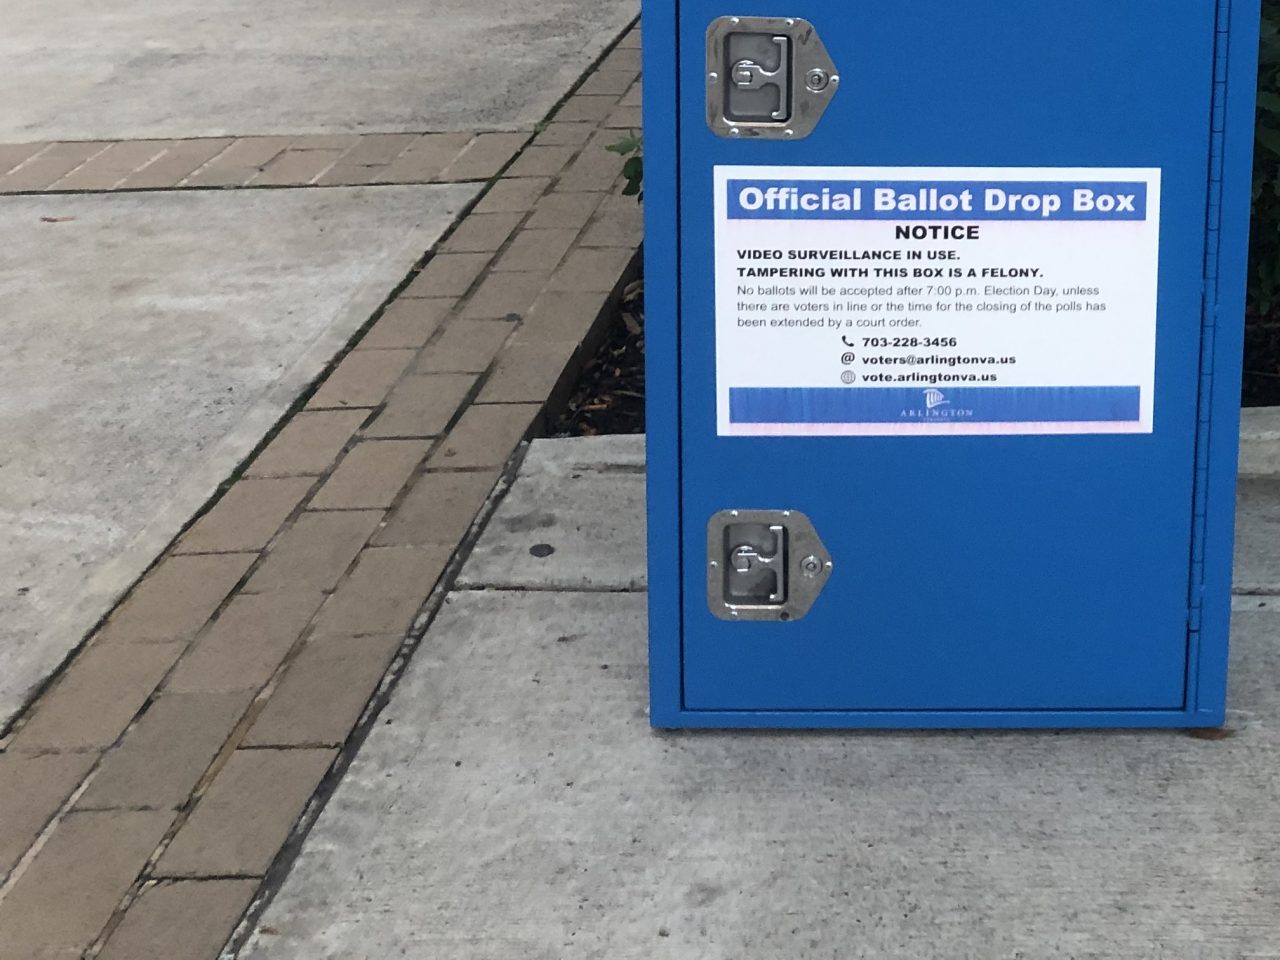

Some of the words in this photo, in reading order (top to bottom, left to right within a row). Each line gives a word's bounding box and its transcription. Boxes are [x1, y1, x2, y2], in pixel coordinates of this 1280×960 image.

[739, 187, 862, 210] Official
[874, 188, 973, 211] Ballot
[984, 189, 1061, 217] Drop
[1073, 189, 1136, 211] Box
[895, 226, 980, 240] NOTICE
[737, 250, 783, 260] VIDEO
[788, 250, 902, 260] SURVEILLANCE
[907, 250, 922, 260] IN
[927, 250, 961, 260] USE.
[737, 268, 825, 278] TAMPERING
[830, 268, 869, 278] WITH
[874, 268, 908, 278] THIS
[913, 268, 943, 278] BOX
[949, 268, 962, 278] IS
[967, 268, 977, 278] A
[982, 268, 1044, 278] FELONY.
[737, 285, 754, 296] No
[757, 285, 796, 296] ballots
[799, 285, 818, 296] will
[821, 285, 836, 296] be
[840, 285, 893, 298] accepted
[896, 285, 922, 296] after
[926, 285, 951, 296] 7:00
[955, 288, 980, 298] p.m.
[984, 285, 1029, 296] Election
[1034, 285, 1058, 298] Day,
[1062, 285, 1100, 296] unless
[737, 301, 767, 312] there
[771, 304, 790, 312] are
[793, 302, 830, 312] voters
[832, 301, 843, 312] in
[847, 301, 867, 312] line
[871, 304, 882, 312] or
[886, 301, 904, 312] the
[908, 301, 933, 312] time
[936, 301, 951, 312] for
[955, 301, 973, 312] the
[976, 301, 1017, 314] closing
[1020, 301, 1031, 312] of
[1034, 301, 1052, 312] the
[1056, 301, 1082, 313] polls
[1086, 301, 1106, 312] has
[737, 317, 766, 328] been
[770, 317, 824, 328] extended
[828, 317, 842, 330] by
[845, 320, 853, 328] a
[856, 317, 885, 328] court
[889, 317, 922, 328] order.
[862, 337, 957, 347] 703-228-3456
[862, 355, 1017, 367] voters@arlingtonva.us
[862, 372, 998, 384] vote.arlingtonva.us
[901, 409, 973, 417] ARLINGTON
